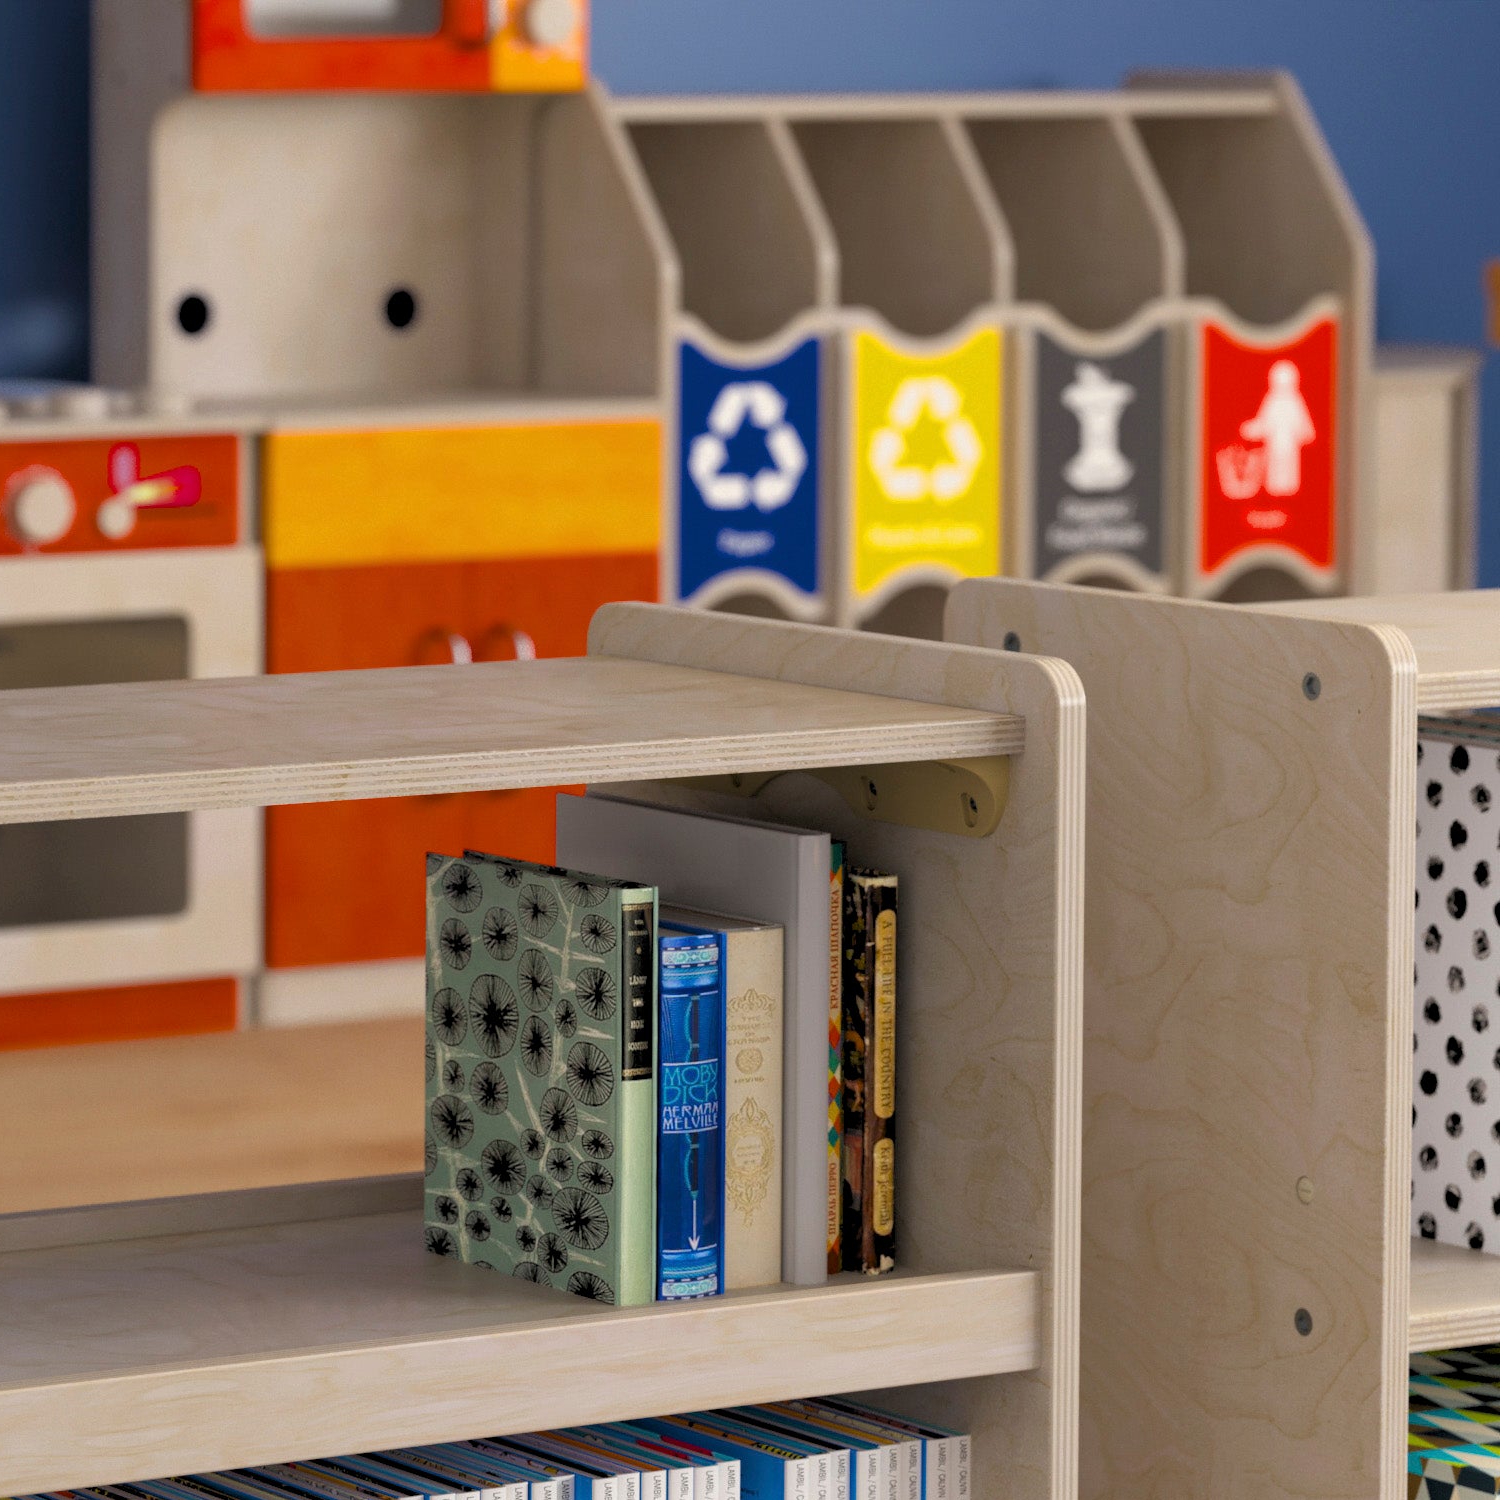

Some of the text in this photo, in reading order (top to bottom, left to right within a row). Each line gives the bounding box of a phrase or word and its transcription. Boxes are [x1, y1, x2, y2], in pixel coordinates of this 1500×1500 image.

[830, 889, 839, 1010] КРАСНАЯ ШАПОЧКА
[882, 1020, 892, 1042] THE
[664, 1062, 719, 1086] MOBY
[882, 1048, 892, 1109] COUNTRY
[663, 1081, 718, 1105] DICK
[663, 1101, 719, 1118] HERMAN
[663, 1112, 719, 1130] MELVILLE
